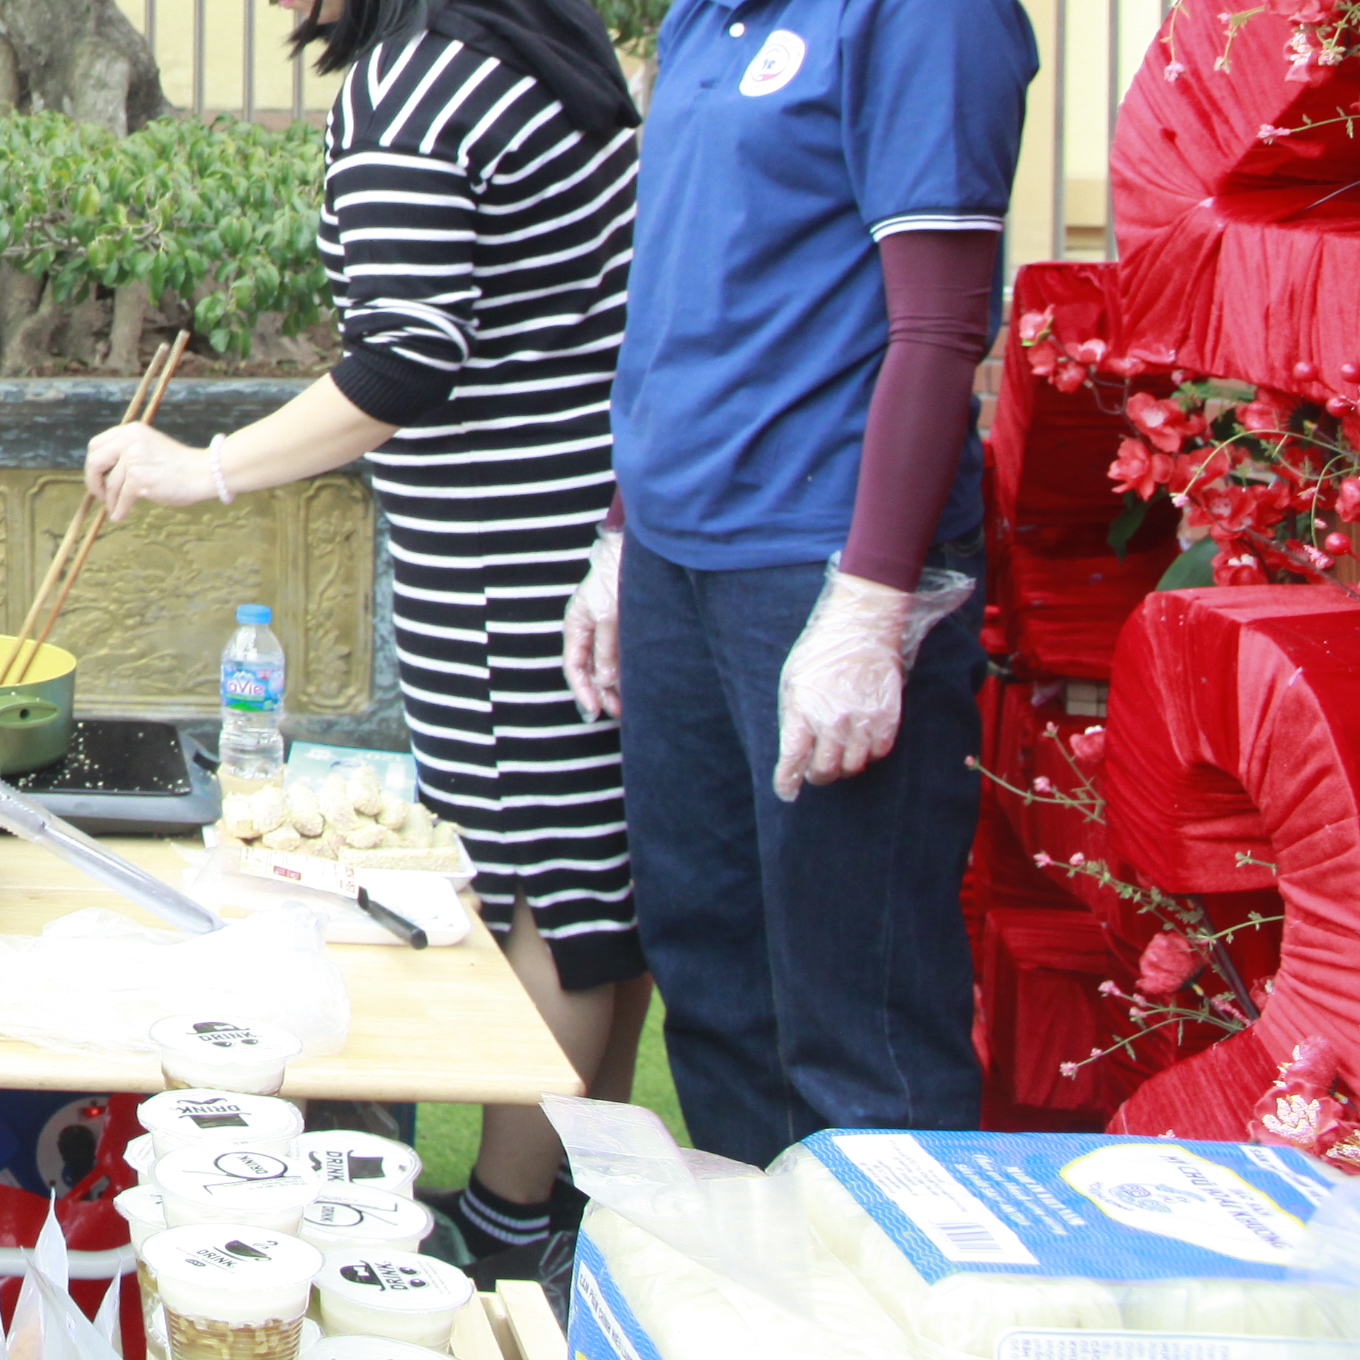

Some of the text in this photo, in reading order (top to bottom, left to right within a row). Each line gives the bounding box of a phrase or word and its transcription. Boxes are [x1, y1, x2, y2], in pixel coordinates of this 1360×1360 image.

[198, 1031, 256, 1043] DRINK
[177, 1103, 242, 1115] DRINK
[236, 1154, 269, 1175] DRINK
[325, 1150, 345, 1183] DRINK
[196, 1249, 239, 1269] DRINK
[374, 1261, 410, 1291] DRINK
